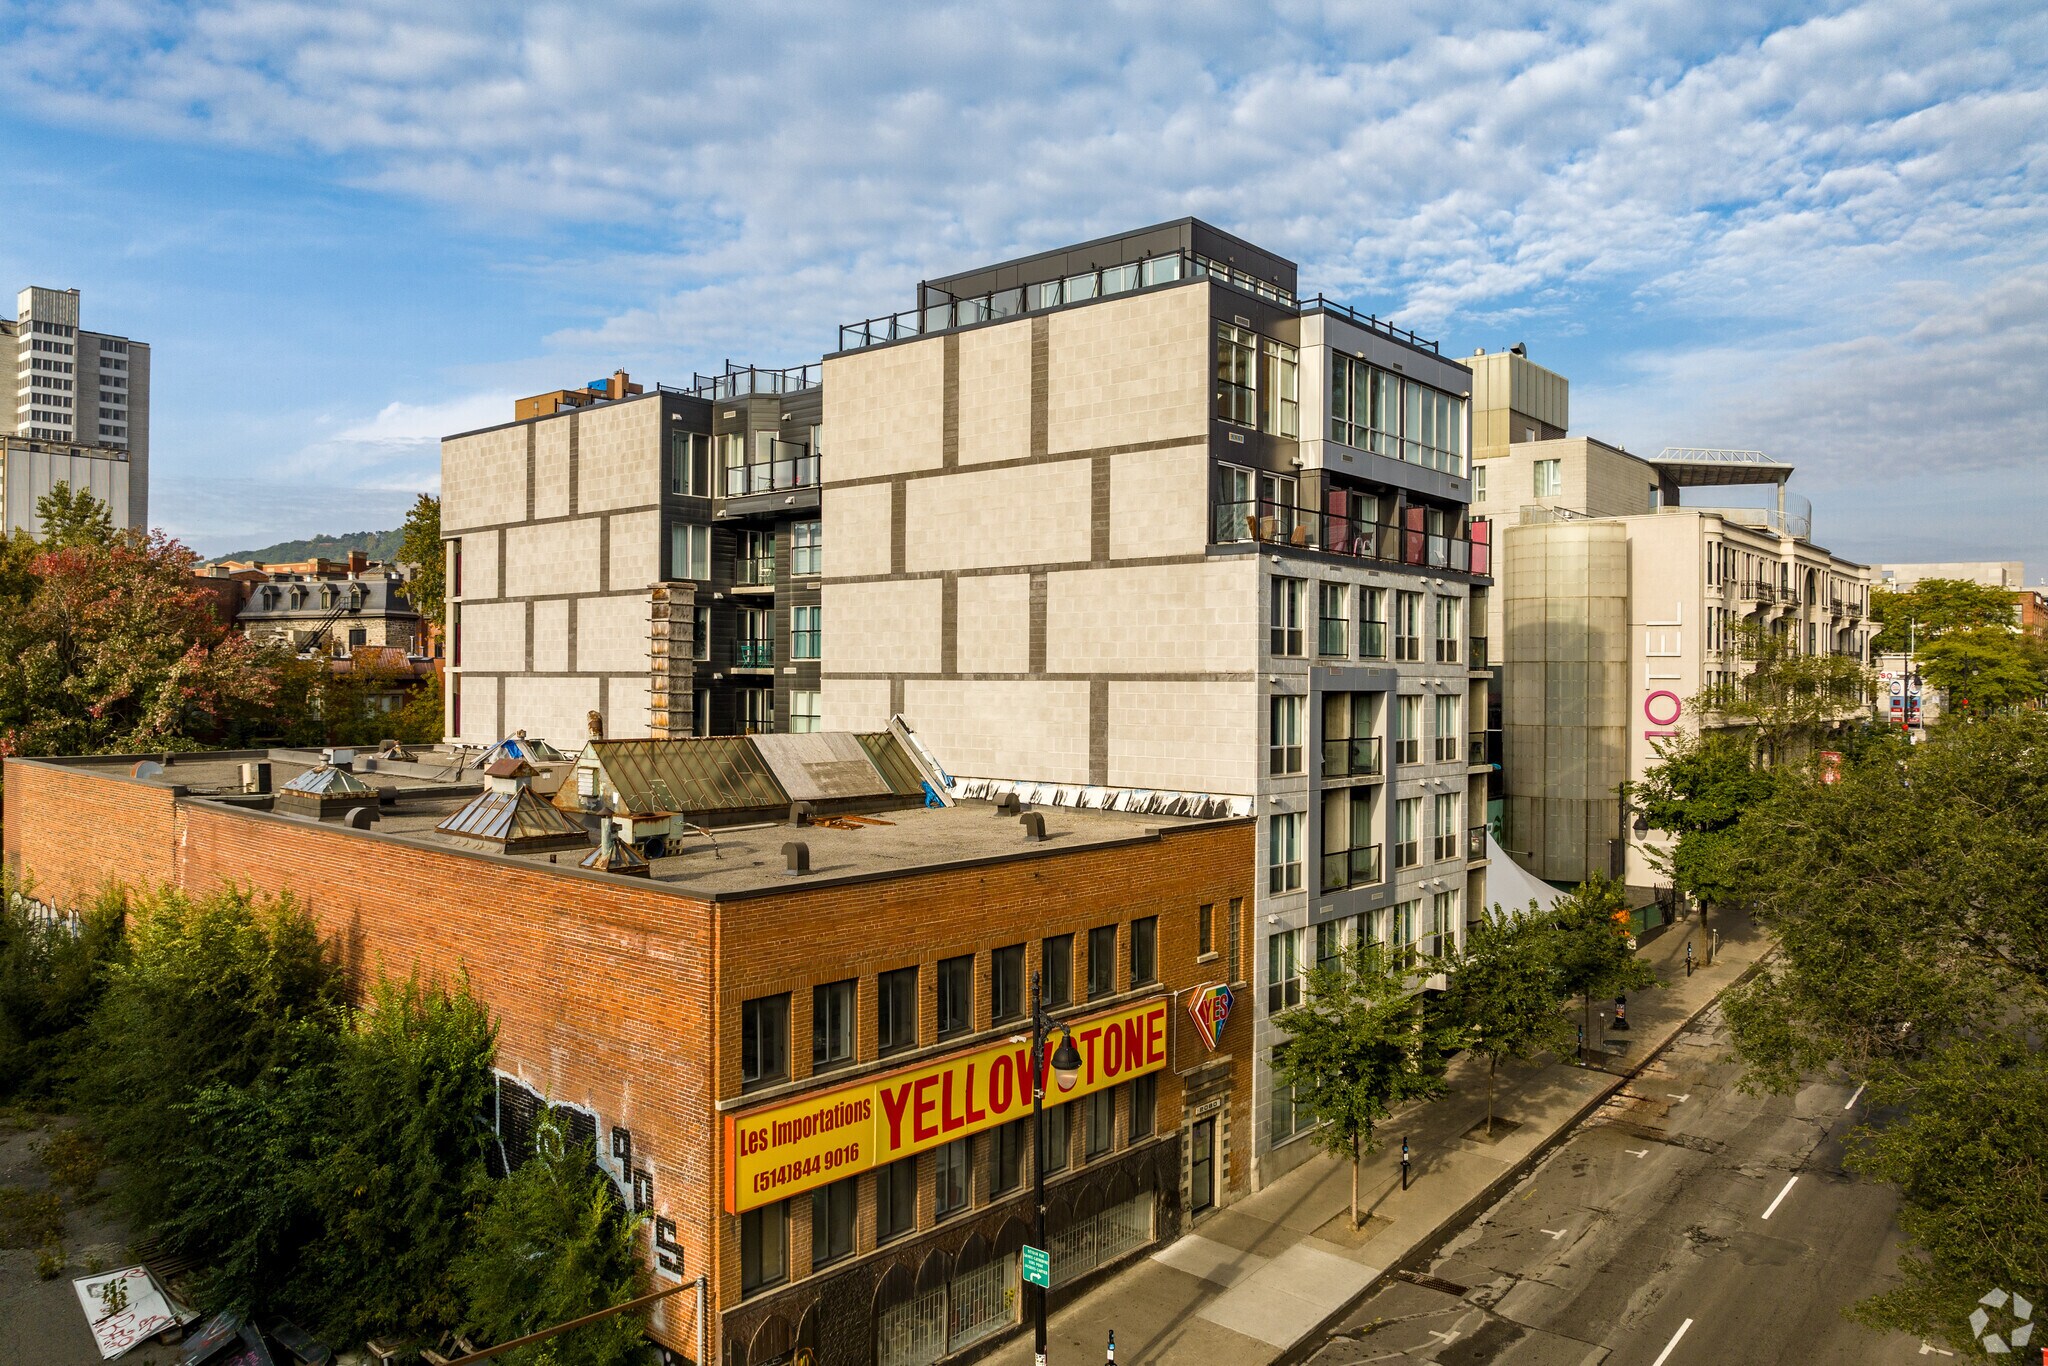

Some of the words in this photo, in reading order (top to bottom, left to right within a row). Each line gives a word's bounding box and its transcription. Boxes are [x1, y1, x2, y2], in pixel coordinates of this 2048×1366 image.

[1202, 993, 1229, 1025] YES
[880, 1009, 1165, 1151] YELLOWTONE
[740, 1127, 768, 1157] Les
[772, 1098, 871, 1148] Importations
[753, 1155, 821, 1193] (514)844
[824, 1142, 860, 1171] 9016
